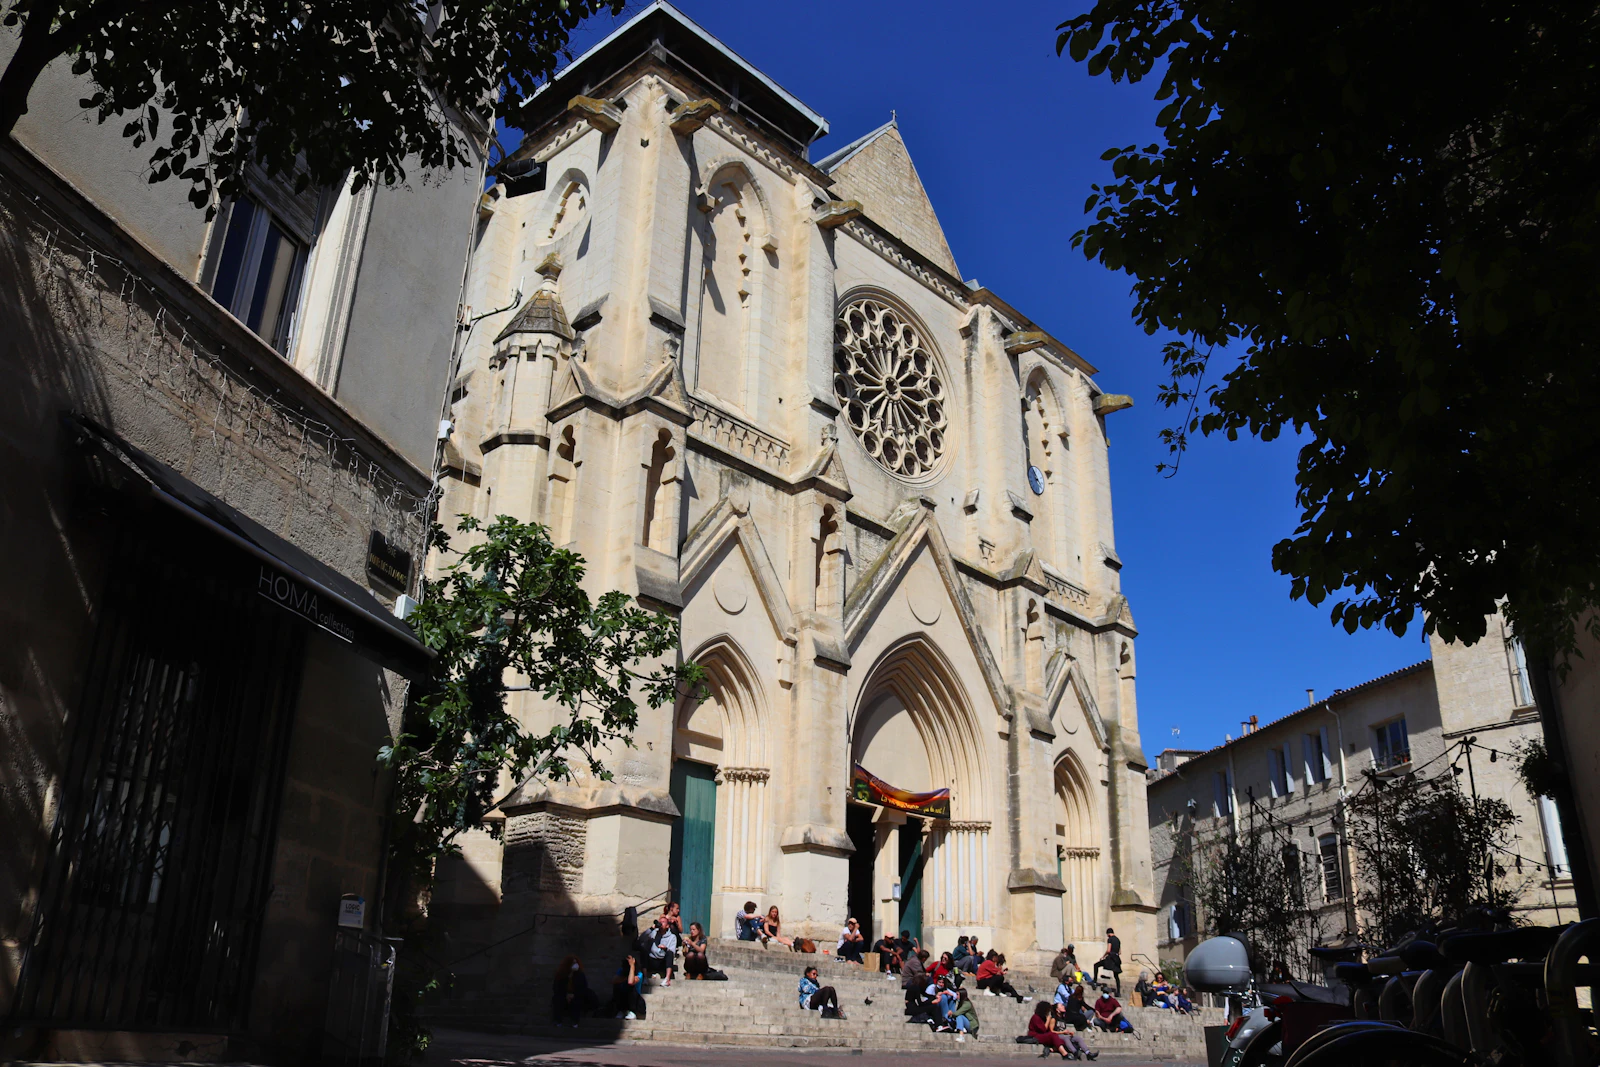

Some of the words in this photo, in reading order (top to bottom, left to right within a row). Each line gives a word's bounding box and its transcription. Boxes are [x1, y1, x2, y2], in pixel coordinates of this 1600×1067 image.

[258, 565, 319, 620] HOMA
[319, 611, 355, 639] collection
[345, 903, 361, 911] LOGIC
